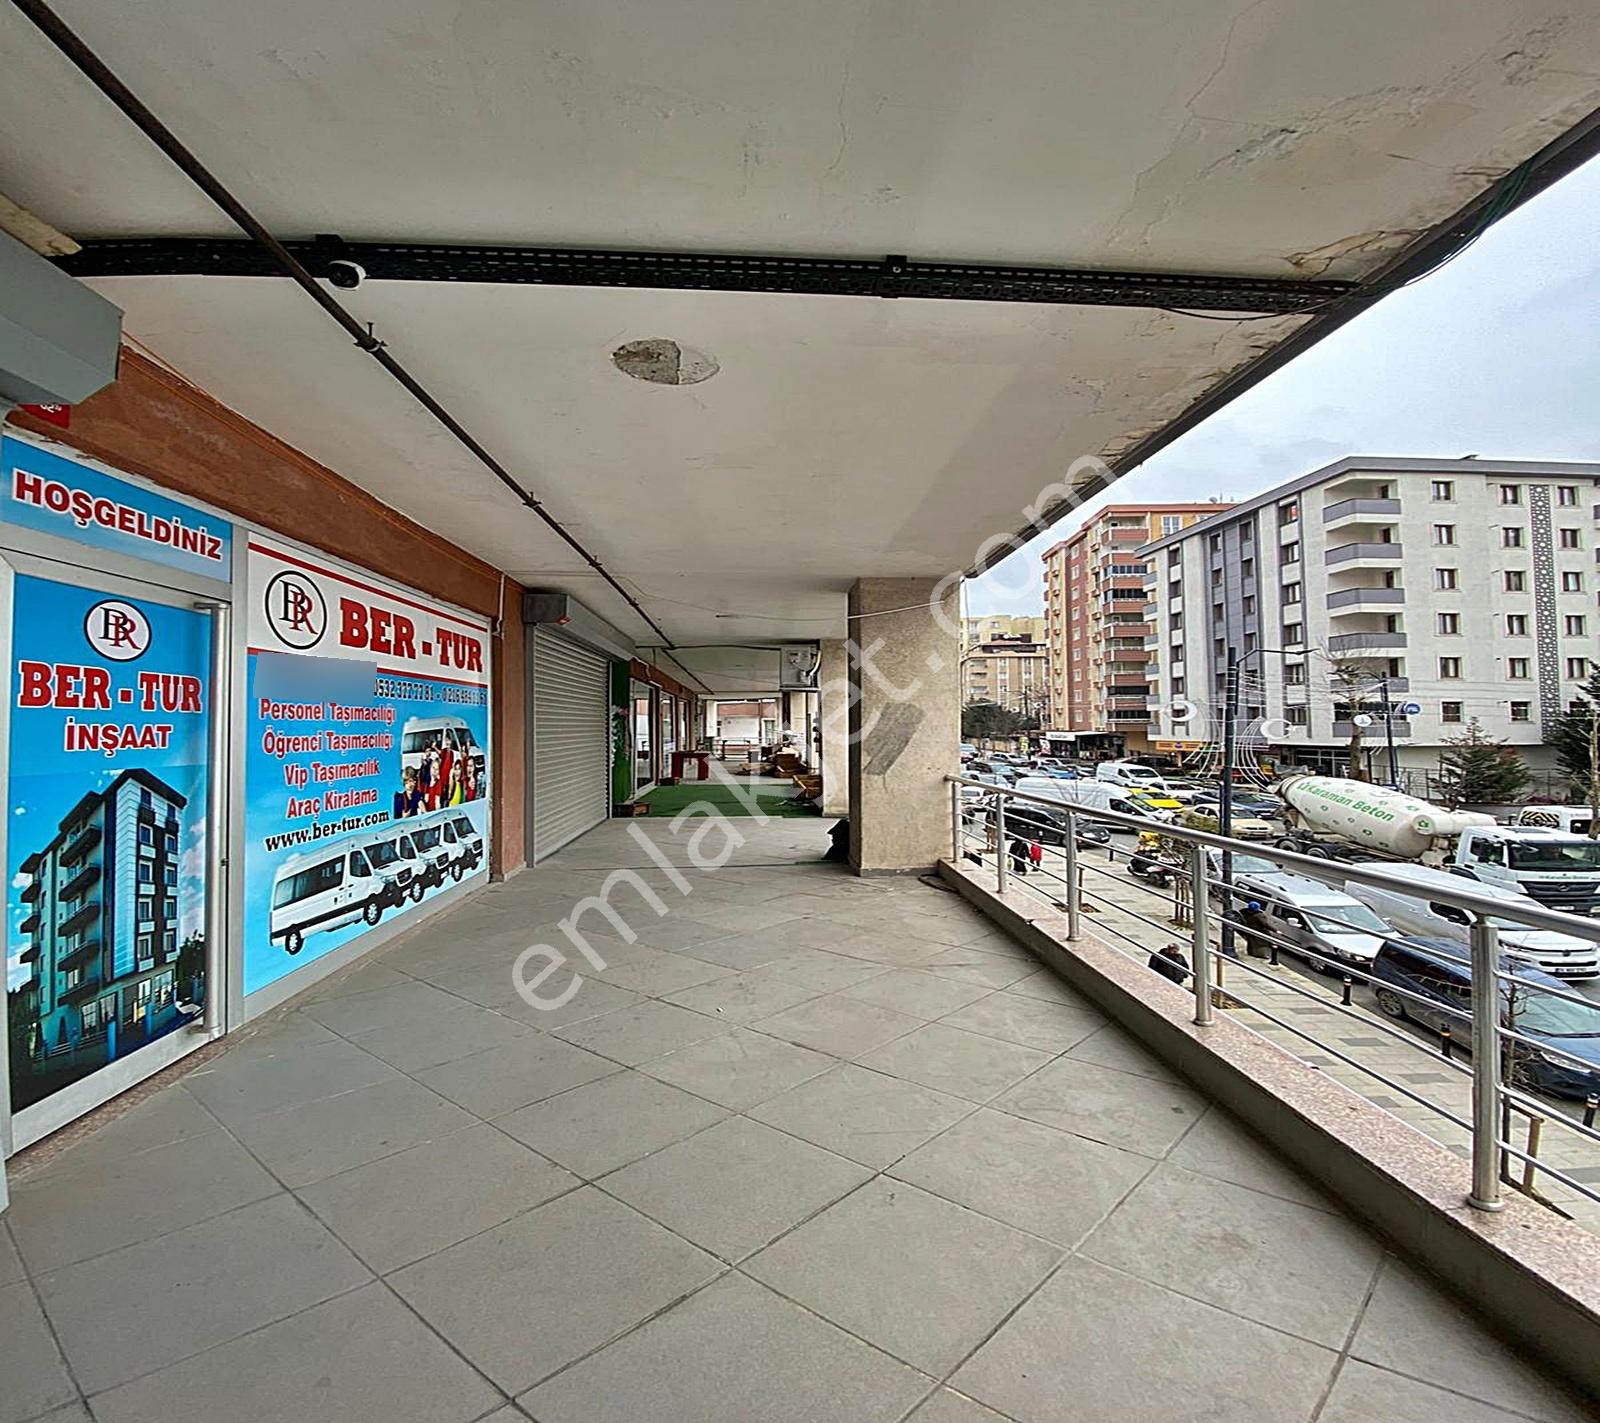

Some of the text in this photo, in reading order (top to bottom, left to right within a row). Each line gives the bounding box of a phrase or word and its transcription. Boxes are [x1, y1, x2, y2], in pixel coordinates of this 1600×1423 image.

[15, 471, 222, 561] HOŞGELDİNİZ
[339, 597, 416, 660] BER
[436, 627, 483, 673] TUR
[19, 661, 111, 709] BER
[140, 672, 202, 713] TUR
[260, 698, 395, 727] Personel Taşımacılığı
[66, 717, 173, 757] İNŞAAT
[263, 725, 393, 759] Öğrenci Taşımacılığı
[284, 759, 380, 790] Vip Taşımacılık
[287, 789, 378, 819] Araç Kiralama
[1308, 784, 1352, 806] Karaman
[1352, 800, 1395, 822] Beton
[264, 811, 390, 851] www.ber-tur.com
